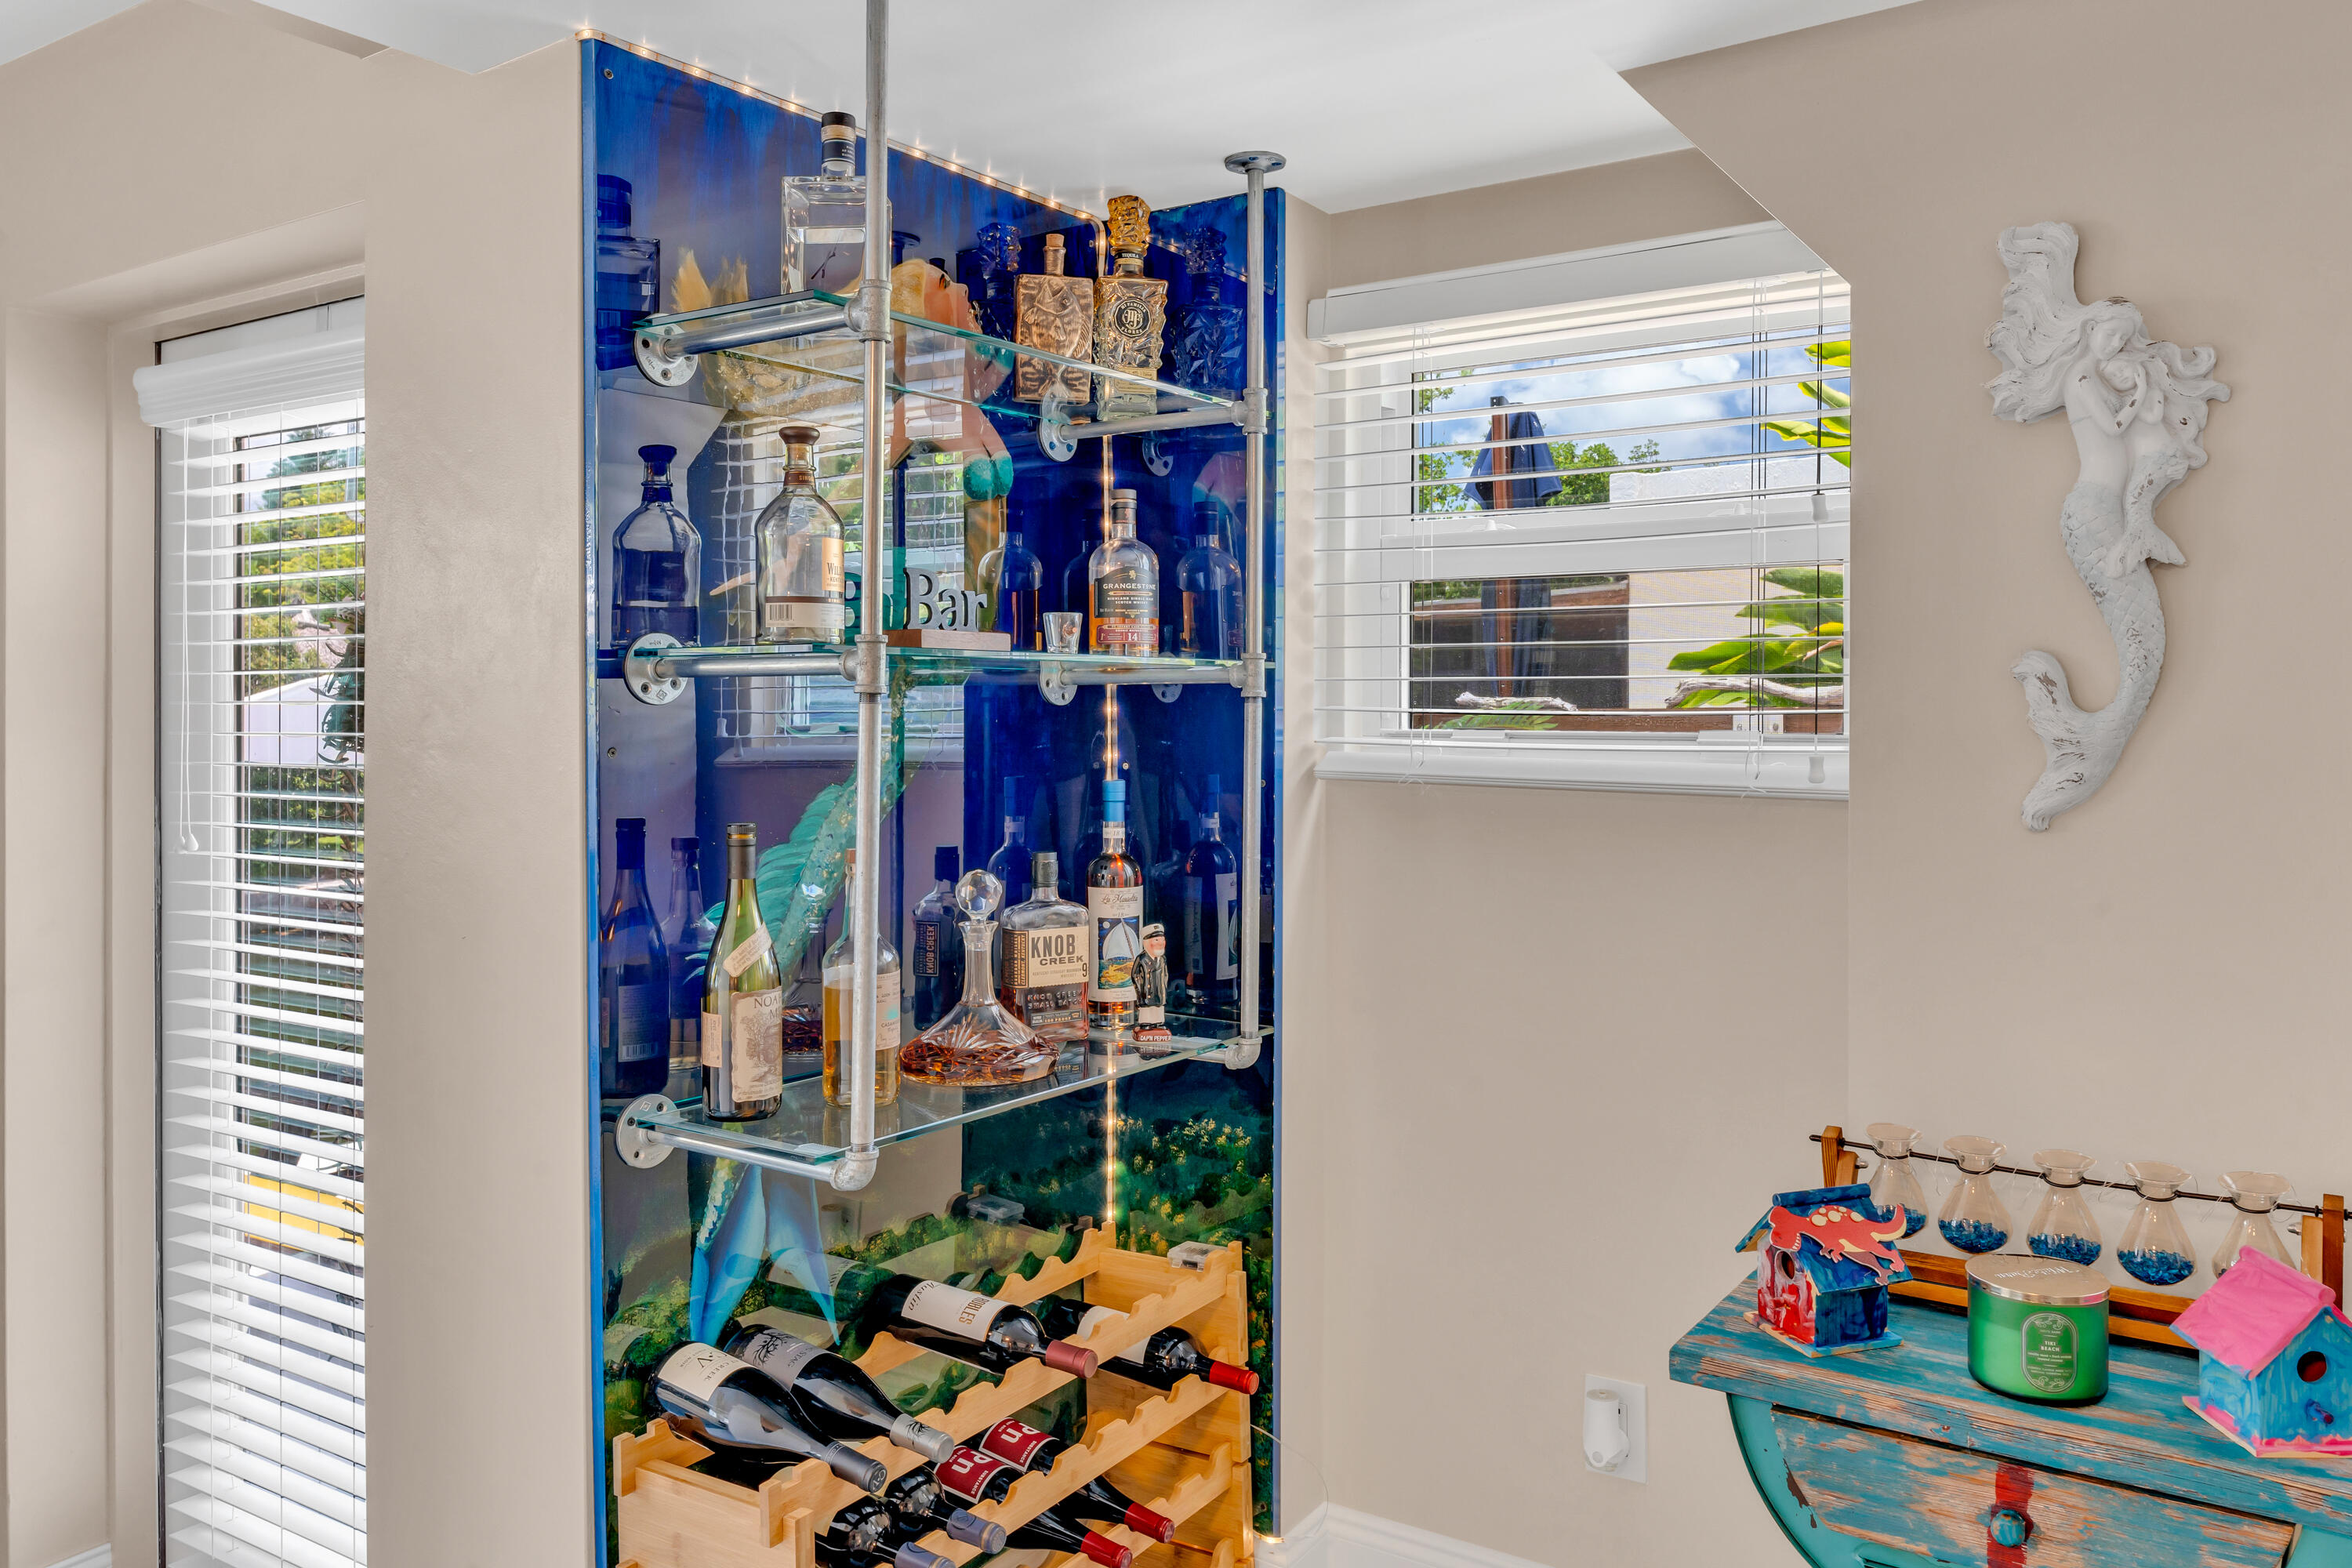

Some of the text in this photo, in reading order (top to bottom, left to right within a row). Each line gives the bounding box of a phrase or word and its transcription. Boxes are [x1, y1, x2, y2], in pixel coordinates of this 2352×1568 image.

[903, 568, 988, 632] Bar
[1127, 633, 1138, 641] 14
[1031, 934, 1076, 959] KNOB
[1040, 954, 1084, 966] CREEK
[1082, 962, 1088, 978] 9
[908, 1282, 941, 1311] Austin
[958, 1296, 991, 1325] ROBLES
[703, 1361, 730, 1381] CREEK
[1000, 1422, 1042, 1443] Pn
[950, 1450, 994, 1475] Pn
[1019, 1440, 1038, 1464] SUBSTANCE
[970, 1469, 989, 1496] SUBSTANCE
